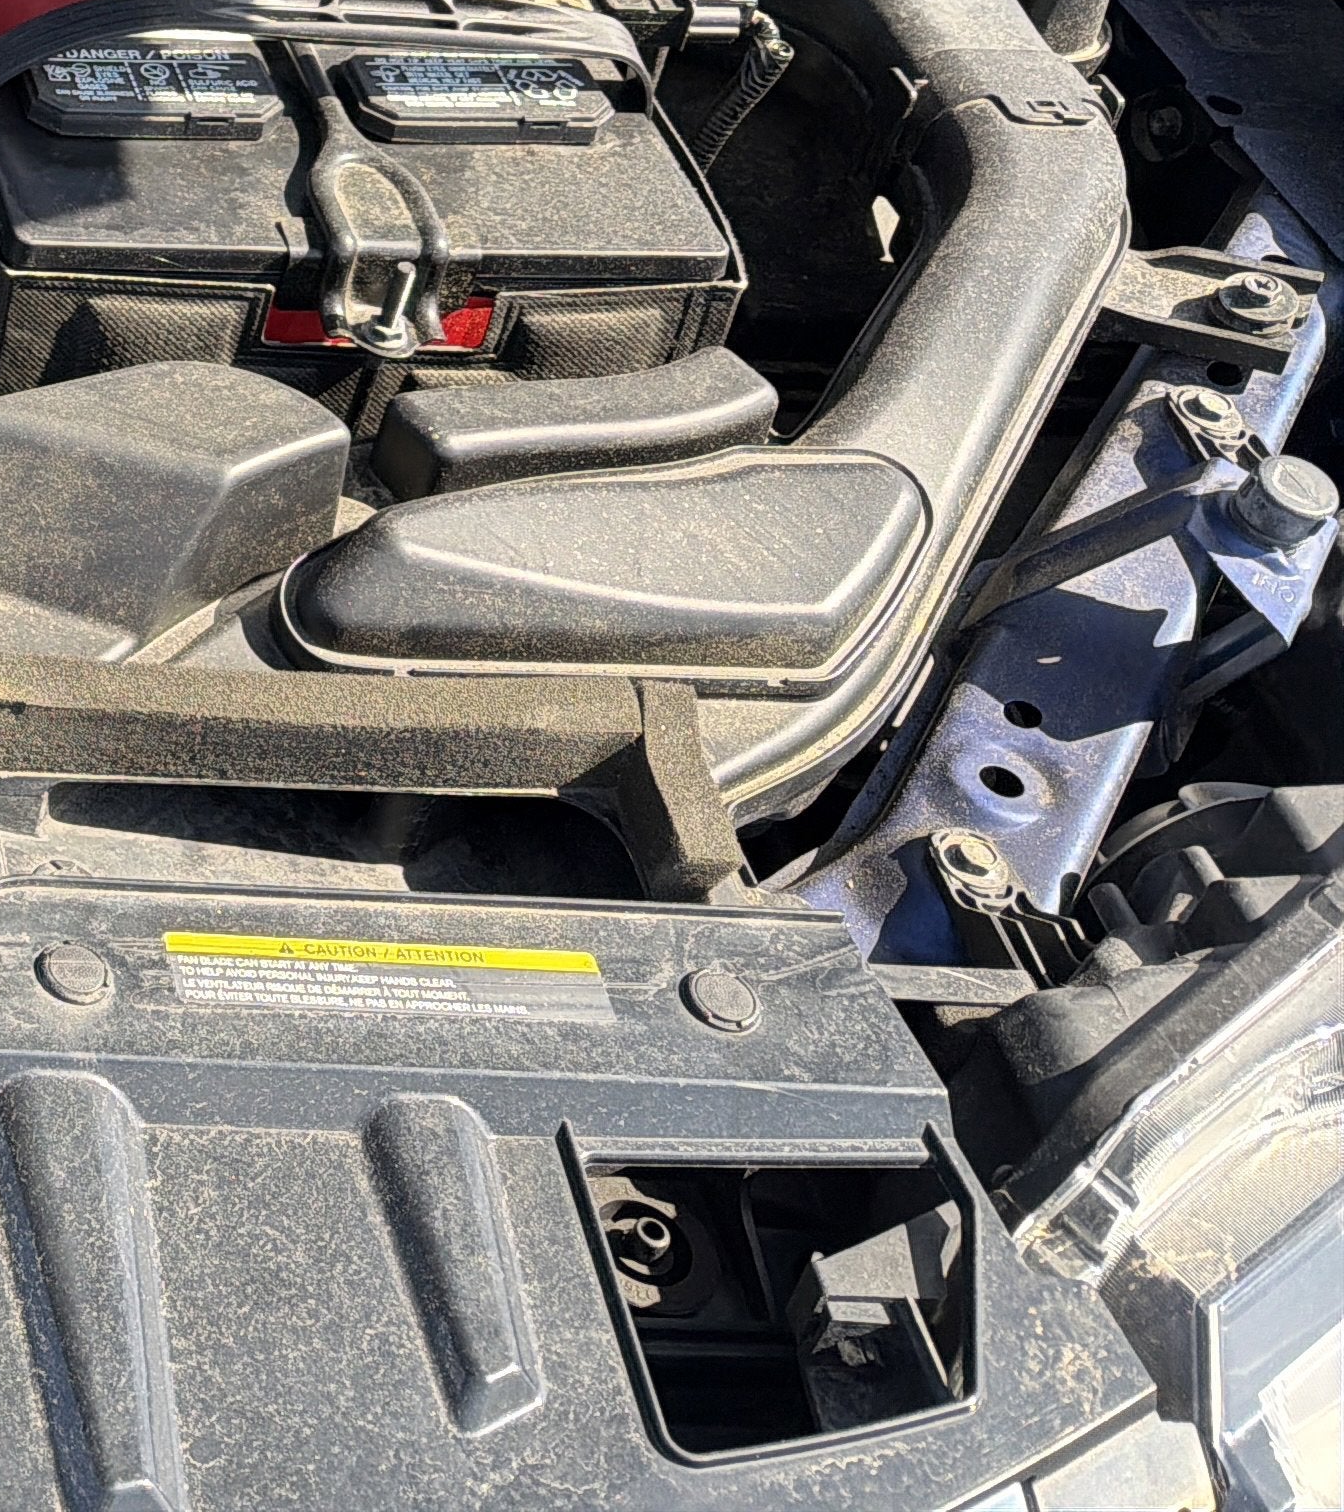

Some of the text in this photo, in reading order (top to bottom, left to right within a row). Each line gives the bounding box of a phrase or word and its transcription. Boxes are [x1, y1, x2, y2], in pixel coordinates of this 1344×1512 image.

[66, 49, 142, 60] DANGER
[161, 49, 231, 61] POISON
[177, 955, 198, 965] FAN
[200, 956, 234, 967] BLADE
[235, 958, 259, 968] CAN
[260, 959, 294, 970] START
[295, 960, 307, 970] AT
[308, 961, 330, 971] ANY
[303, 943, 377, 958] CAUTION
[396, 948, 484, 963] ATTENTION
[181, 966, 195, 976] TO
[197, 967, 224, 977] HELP
[225, 968, 257, 979] AVOID
[258, 969, 315, 981] PERSONAL
[380, 976, 418, 986] HANDS
[183, 978, 196, 988] LE
[197, 979, 265, 991] VENTILATEUR
[266, 982, 306, 993] RISQUE
[308, 984, 322, 994] DE
[393, 989, 419, 999] TOUT
[185, 990, 217, 1000] POUR
[218, 989, 254, 1001] ÉVITER
[255, 992, 289, 1003] TOUTE
[349, 997, 365, 1007] NE
[366, 998, 387, 1008] PAS
[389, 1000, 405, 1009] EN
[406, 1001, 471, 1013] APPROCHER
[472, 1003, 492, 1013] LES
